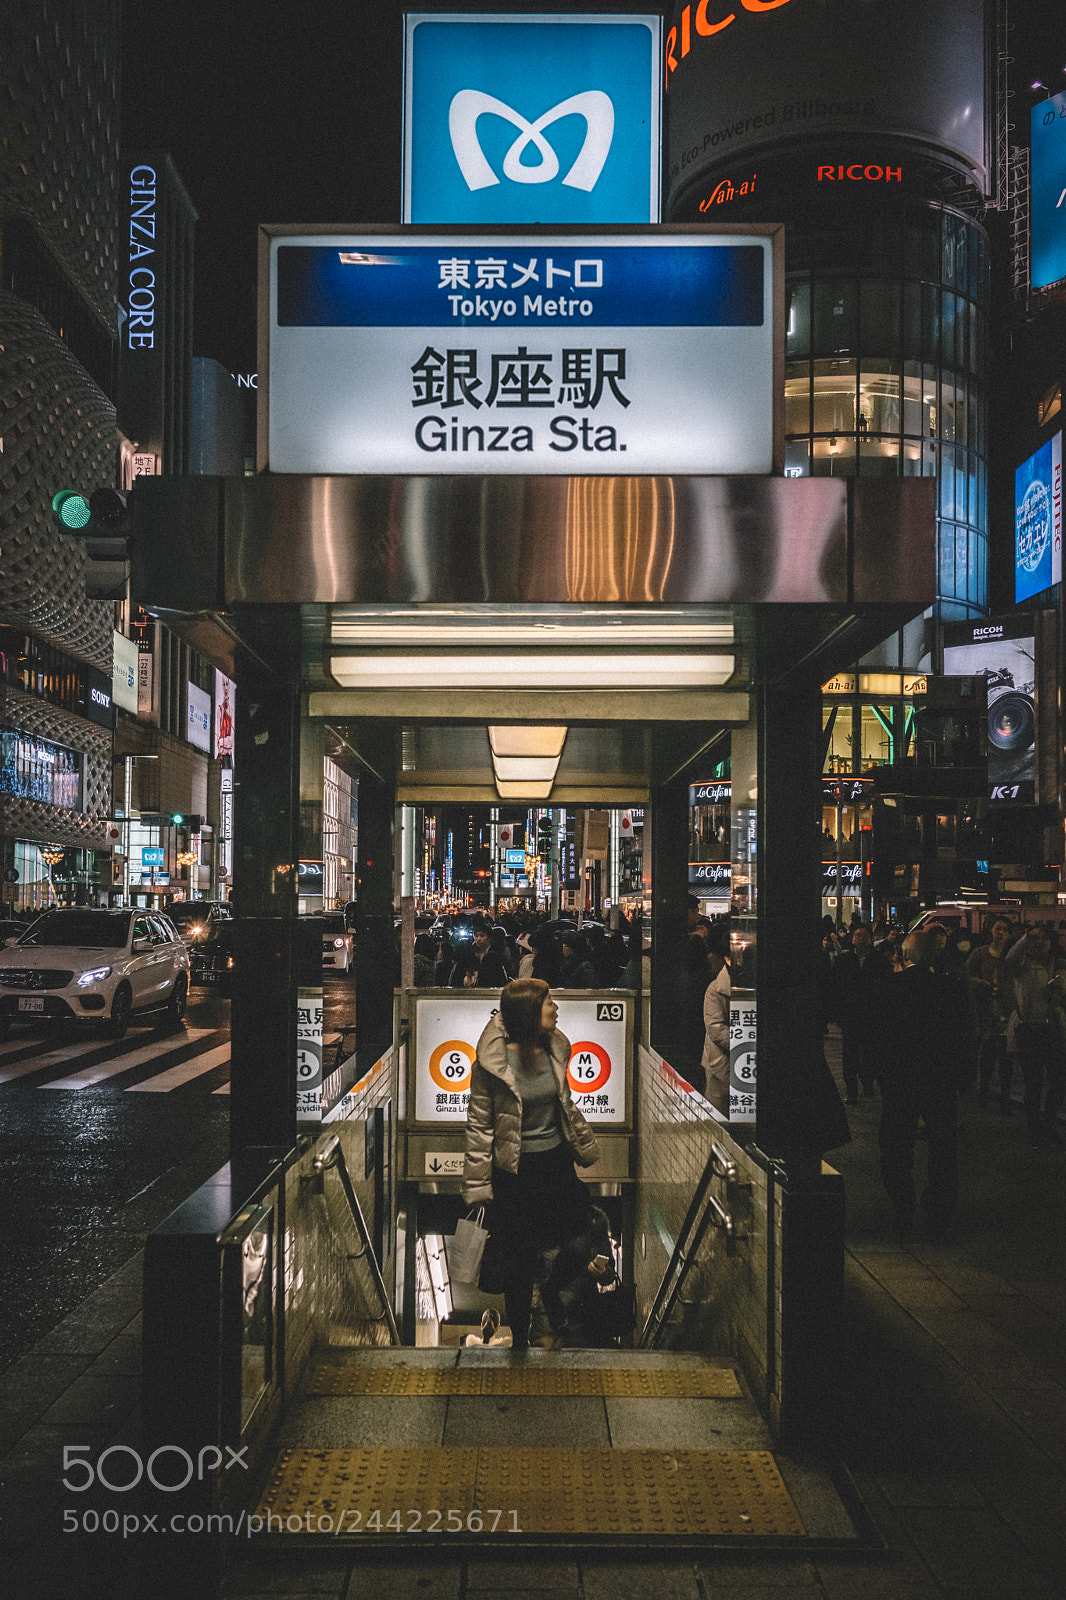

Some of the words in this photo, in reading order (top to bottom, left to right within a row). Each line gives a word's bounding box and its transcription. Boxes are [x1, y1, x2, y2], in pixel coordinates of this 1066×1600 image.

[817, 164, 902, 183] RICOH
[129, 165, 156, 261] GINZA
[437, 257, 604, 290] 東京メトロ
[128, 268, 156, 350] CORE
[447, 295, 517, 321] Tokyo
[523, 295, 594, 317] Metro
[410, 346, 631, 410] 銀座駅
[415, 415, 534, 452] Ginza
[548, 415, 628, 452] Sta.
[134, 456, 153, 466] 地下
[973, 625, 1003, 636] RICOH
[91, 688, 110, 708] SONY
[991, 784, 1020, 800] K-1
[598, 1004, 622, 1021] A9
[449, 1052, 461, 1065] G
[578, 1053, 592, 1065] M
[445, 1066, 465, 1079] 09
[576, 1066, 595, 1080] 16
[600, 1106, 616, 1114] Line
